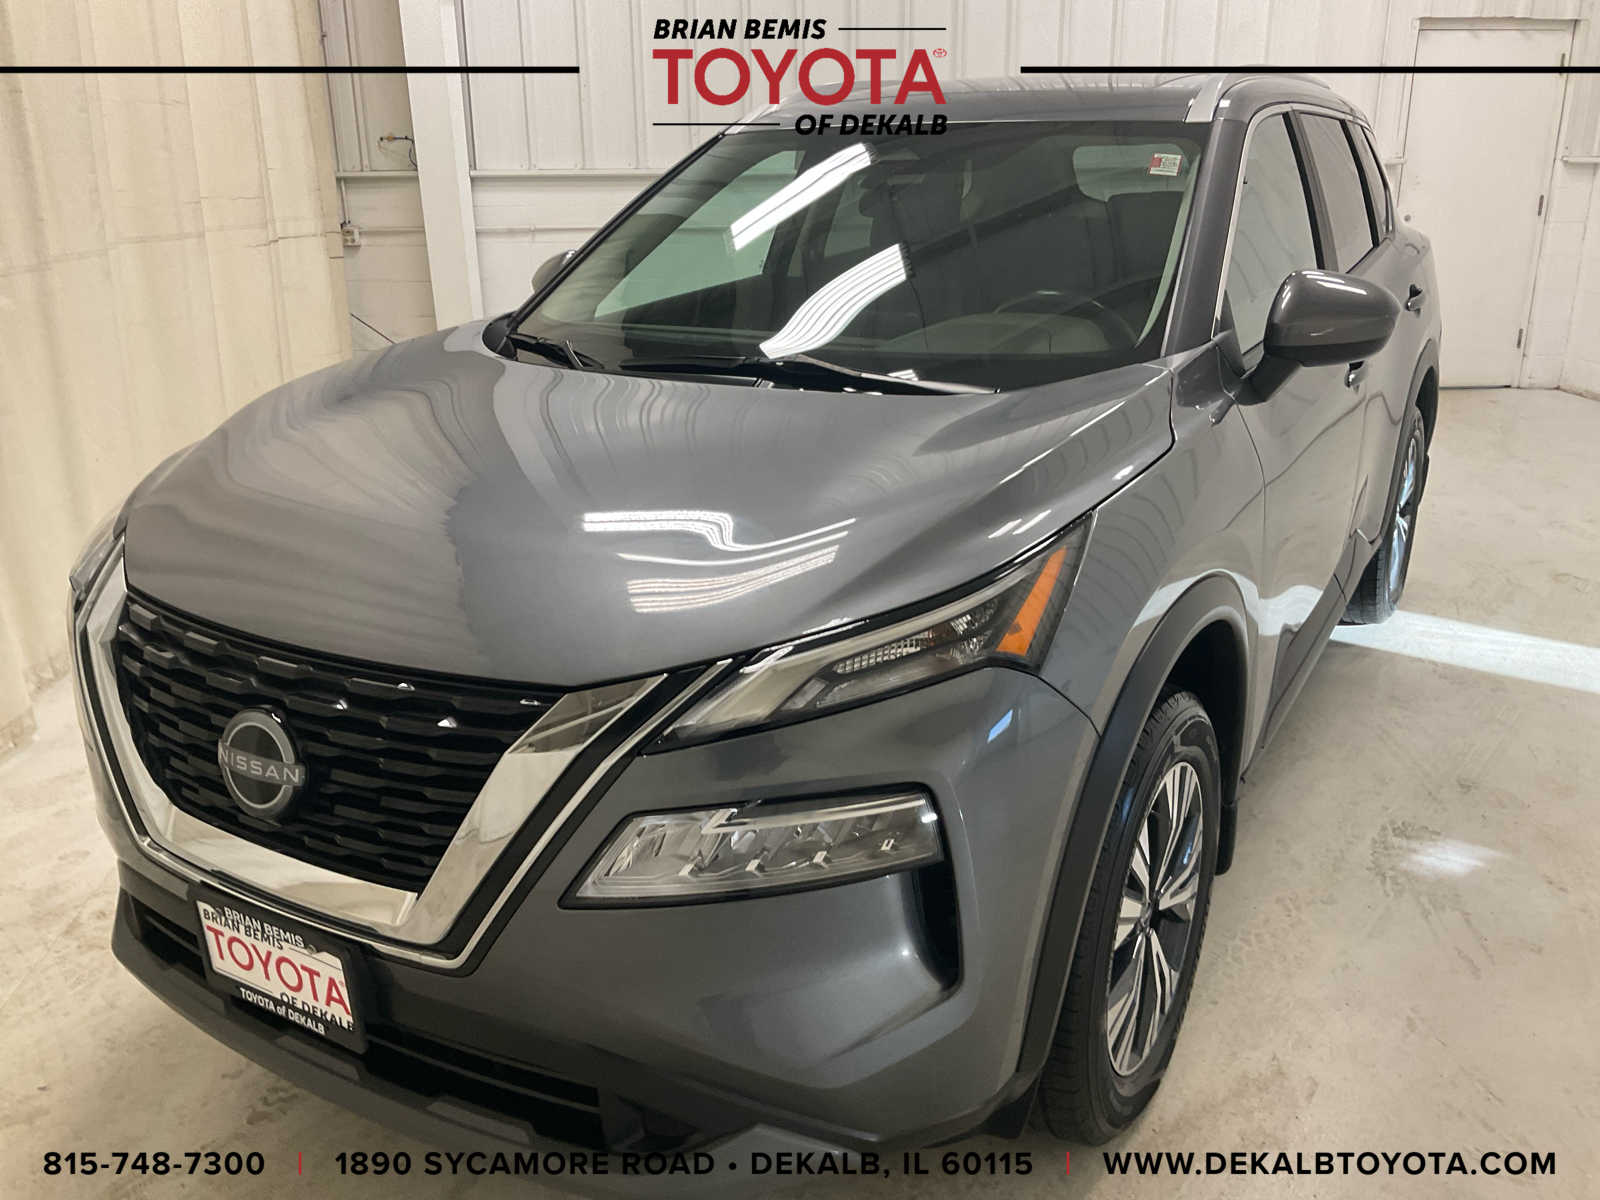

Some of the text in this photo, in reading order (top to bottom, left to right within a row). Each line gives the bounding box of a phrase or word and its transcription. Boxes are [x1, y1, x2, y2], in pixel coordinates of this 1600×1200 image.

[219, 742, 299, 783] NISSAN
[224, 906, 305, 948] BRIAN BEMIS
[206, 925, 352, 1016] TOYOTA
[240, 987, 276, 1012] TOYOTA
[288, 1009, 325, 1035] DEKALB
